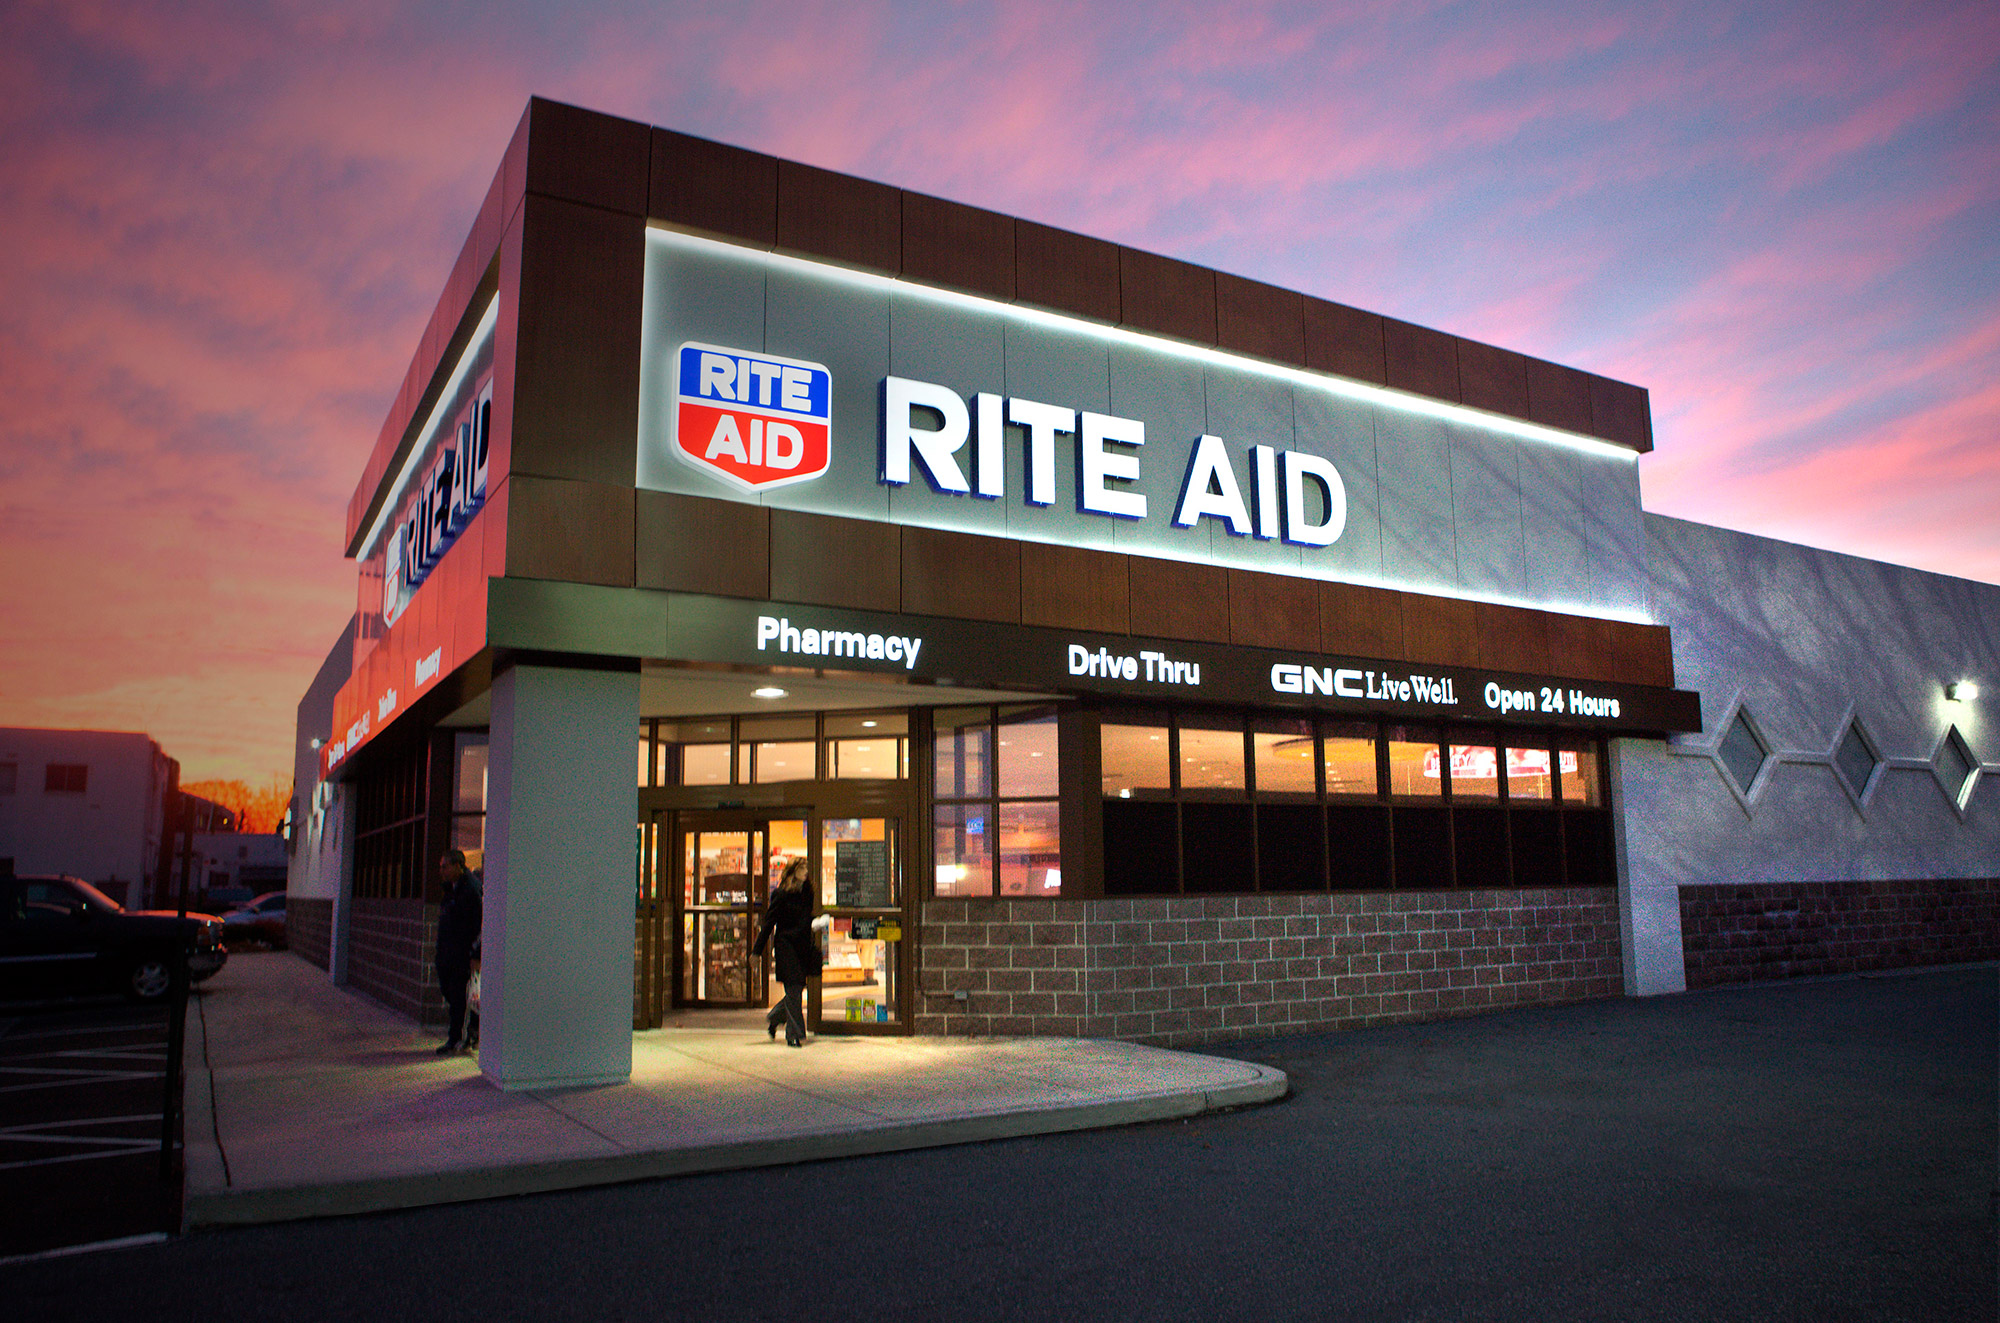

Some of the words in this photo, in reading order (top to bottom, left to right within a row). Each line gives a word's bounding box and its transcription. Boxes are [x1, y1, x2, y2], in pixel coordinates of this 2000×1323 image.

[700, 352, 812, 412] RITE
[705, 414, 804, 470] AID
[880, 375, 1148, 520] RITE
[1173, 434, 1348, 547] AID
[404, 449, 452, 588] RITE
[447, 376, 494, 533] AID
[757, 615, 922, 670] Pharmacy
[1068, 644, 1139, 681] Drive
[1140, 650, 1200, 685] Thru
[1270, 663, 1364, 698] GNC
[1484, 681, 1536, 715] Open
[1541, 686, 1565, 714] 24
[1569, 689, 1621, 718] Hours
